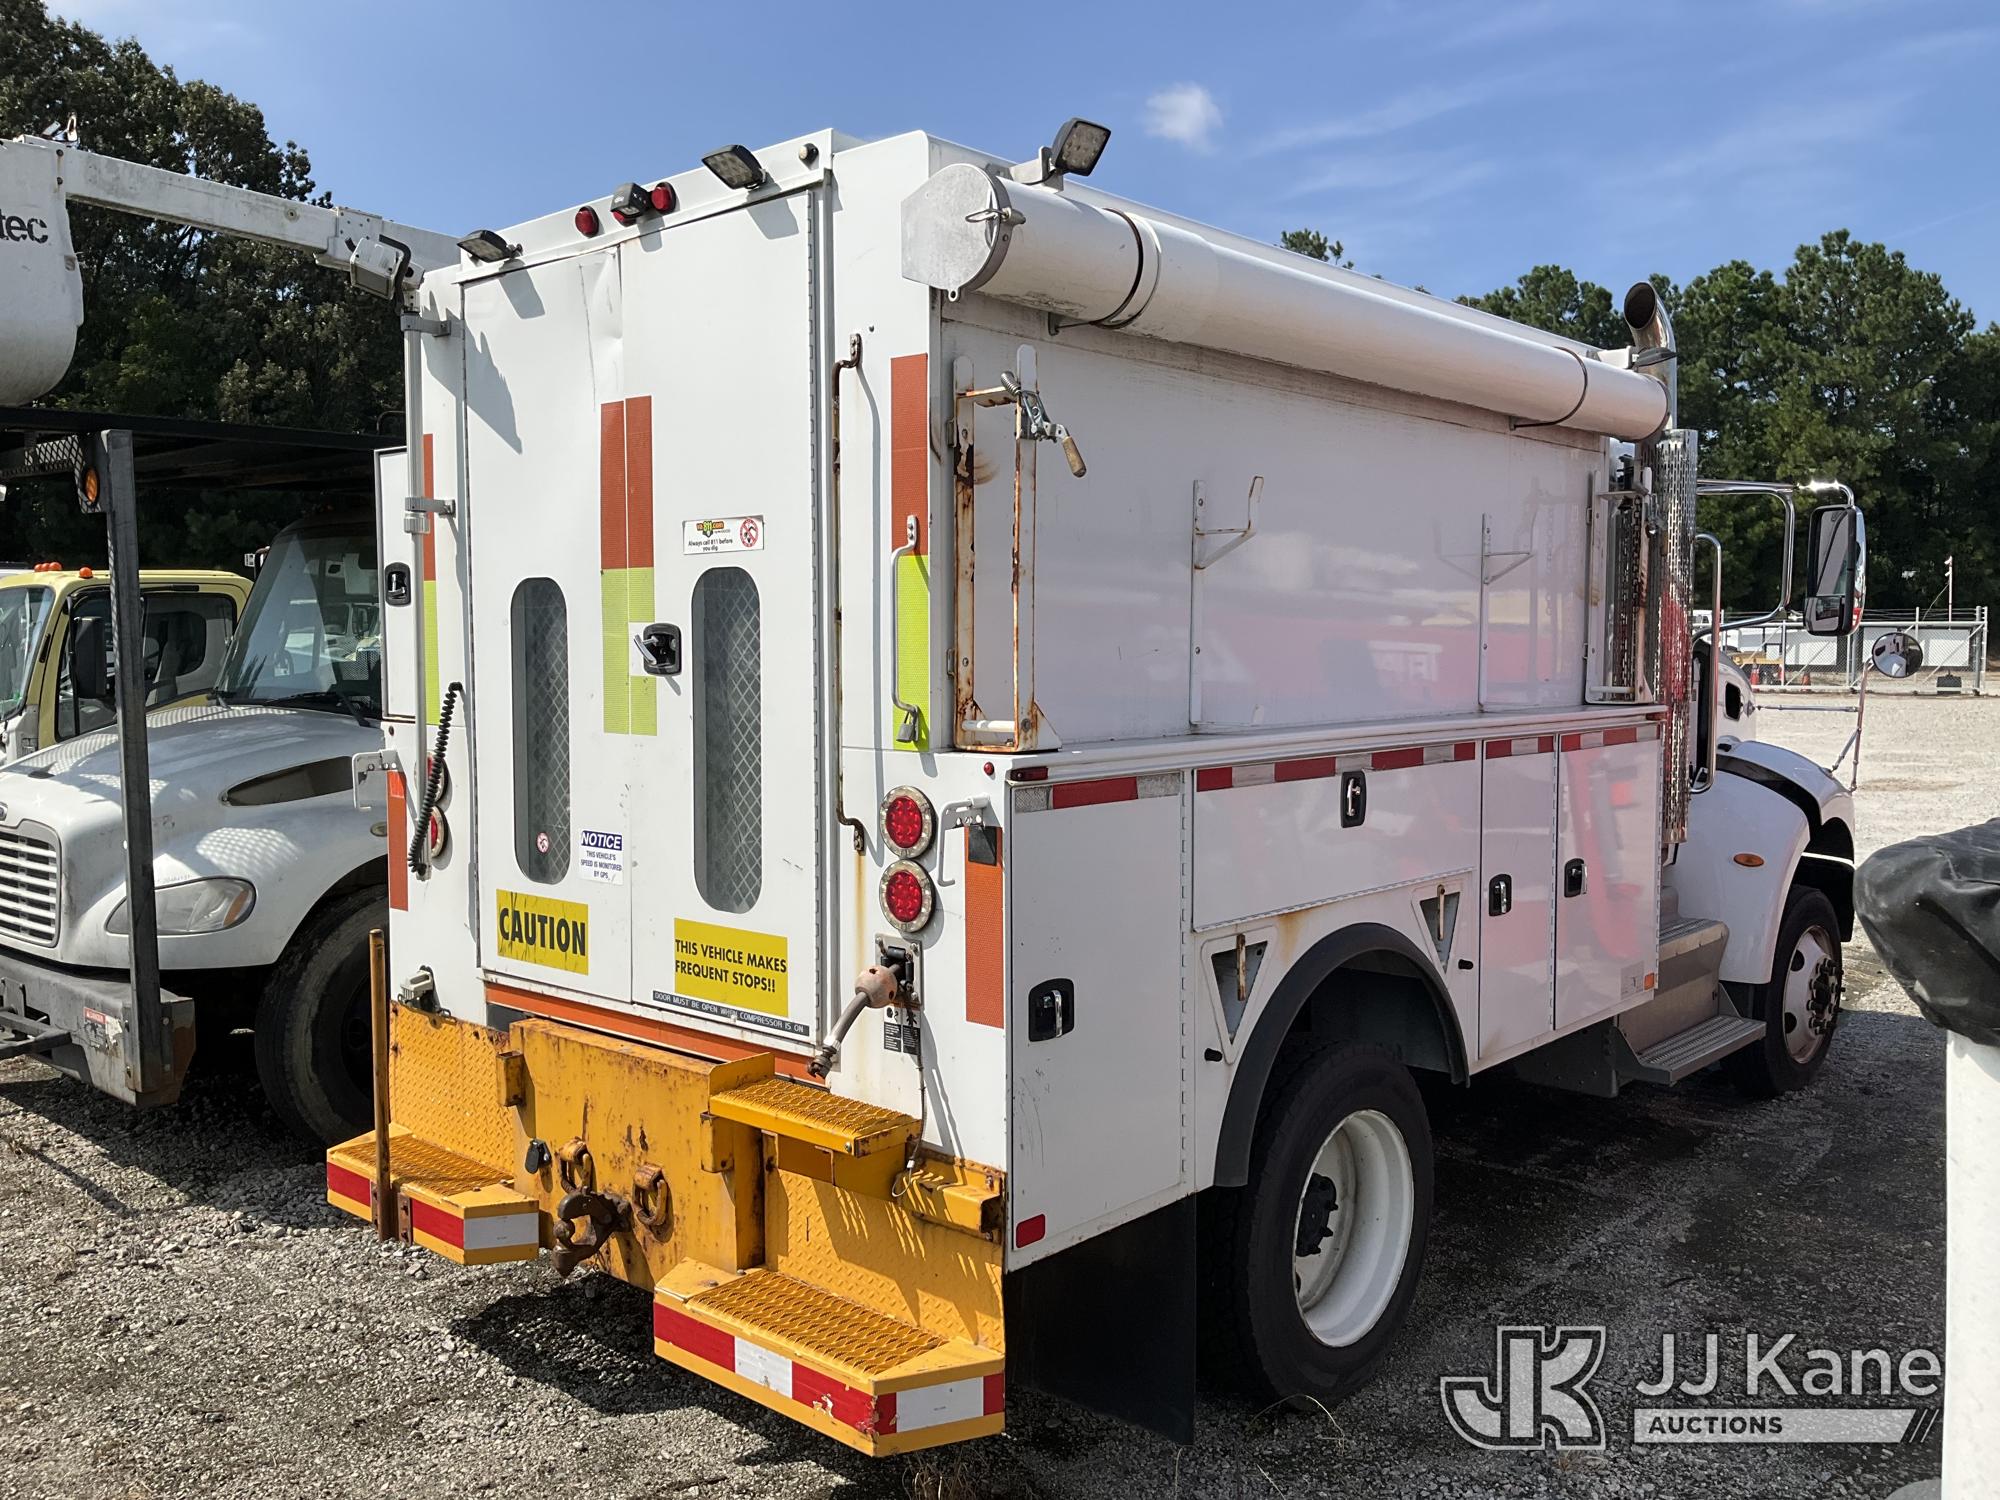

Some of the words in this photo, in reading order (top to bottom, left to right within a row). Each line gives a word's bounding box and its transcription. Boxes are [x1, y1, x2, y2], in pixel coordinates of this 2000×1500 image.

[581, 832, 621, 850] NOTICE
[586, 850, 595, 858] THIS
[596, 852, 616, 861] VEHICLE'S
[581, 859, 593, 867] SPEED
[599, 863, 622, 872] MONITORED
[500, 908, 586, 956] CAUTION
[675, 939, 698, 956] THIS
[701, 944, 743, 964] VEHICLE
[747, 953, 787, 973] MAKES
[675, 960, 728, 983] FREQUENT
[732, 971, 775, 992] STOPS!!
[655, 992, 671, 1002] DOOR
[673, 996, 689, 1006] MUST
[702, 1003, 718, 1013] OPEN
[740, 1012, 783, 1028] COMPRESSOR
[794, 1025, 804, 1033] ON
